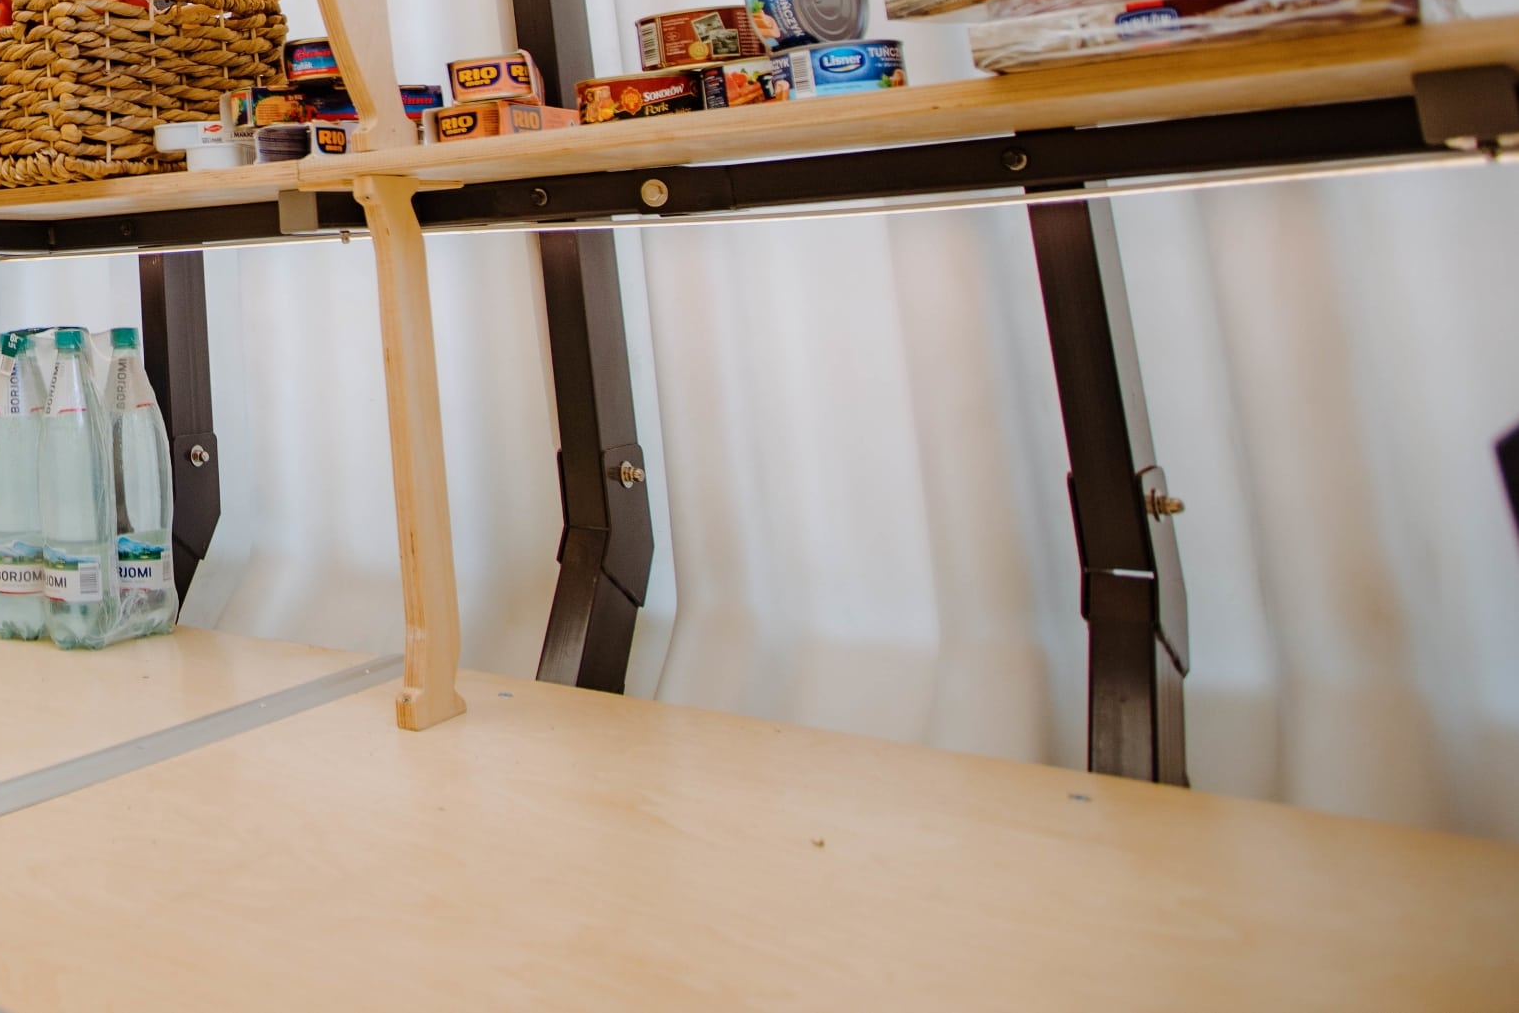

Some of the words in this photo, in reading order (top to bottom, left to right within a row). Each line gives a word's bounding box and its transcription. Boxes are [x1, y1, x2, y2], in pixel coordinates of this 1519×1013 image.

[822, 54, 863, 67] Lisner
[459, 65, 498, 83] RIO
[440, 115, 475, 131] RIO
[512, 108, 543, 130] RIO
[316, 129, 346, 145] RIO
[116, 358, 128, 409] BORJOMI
